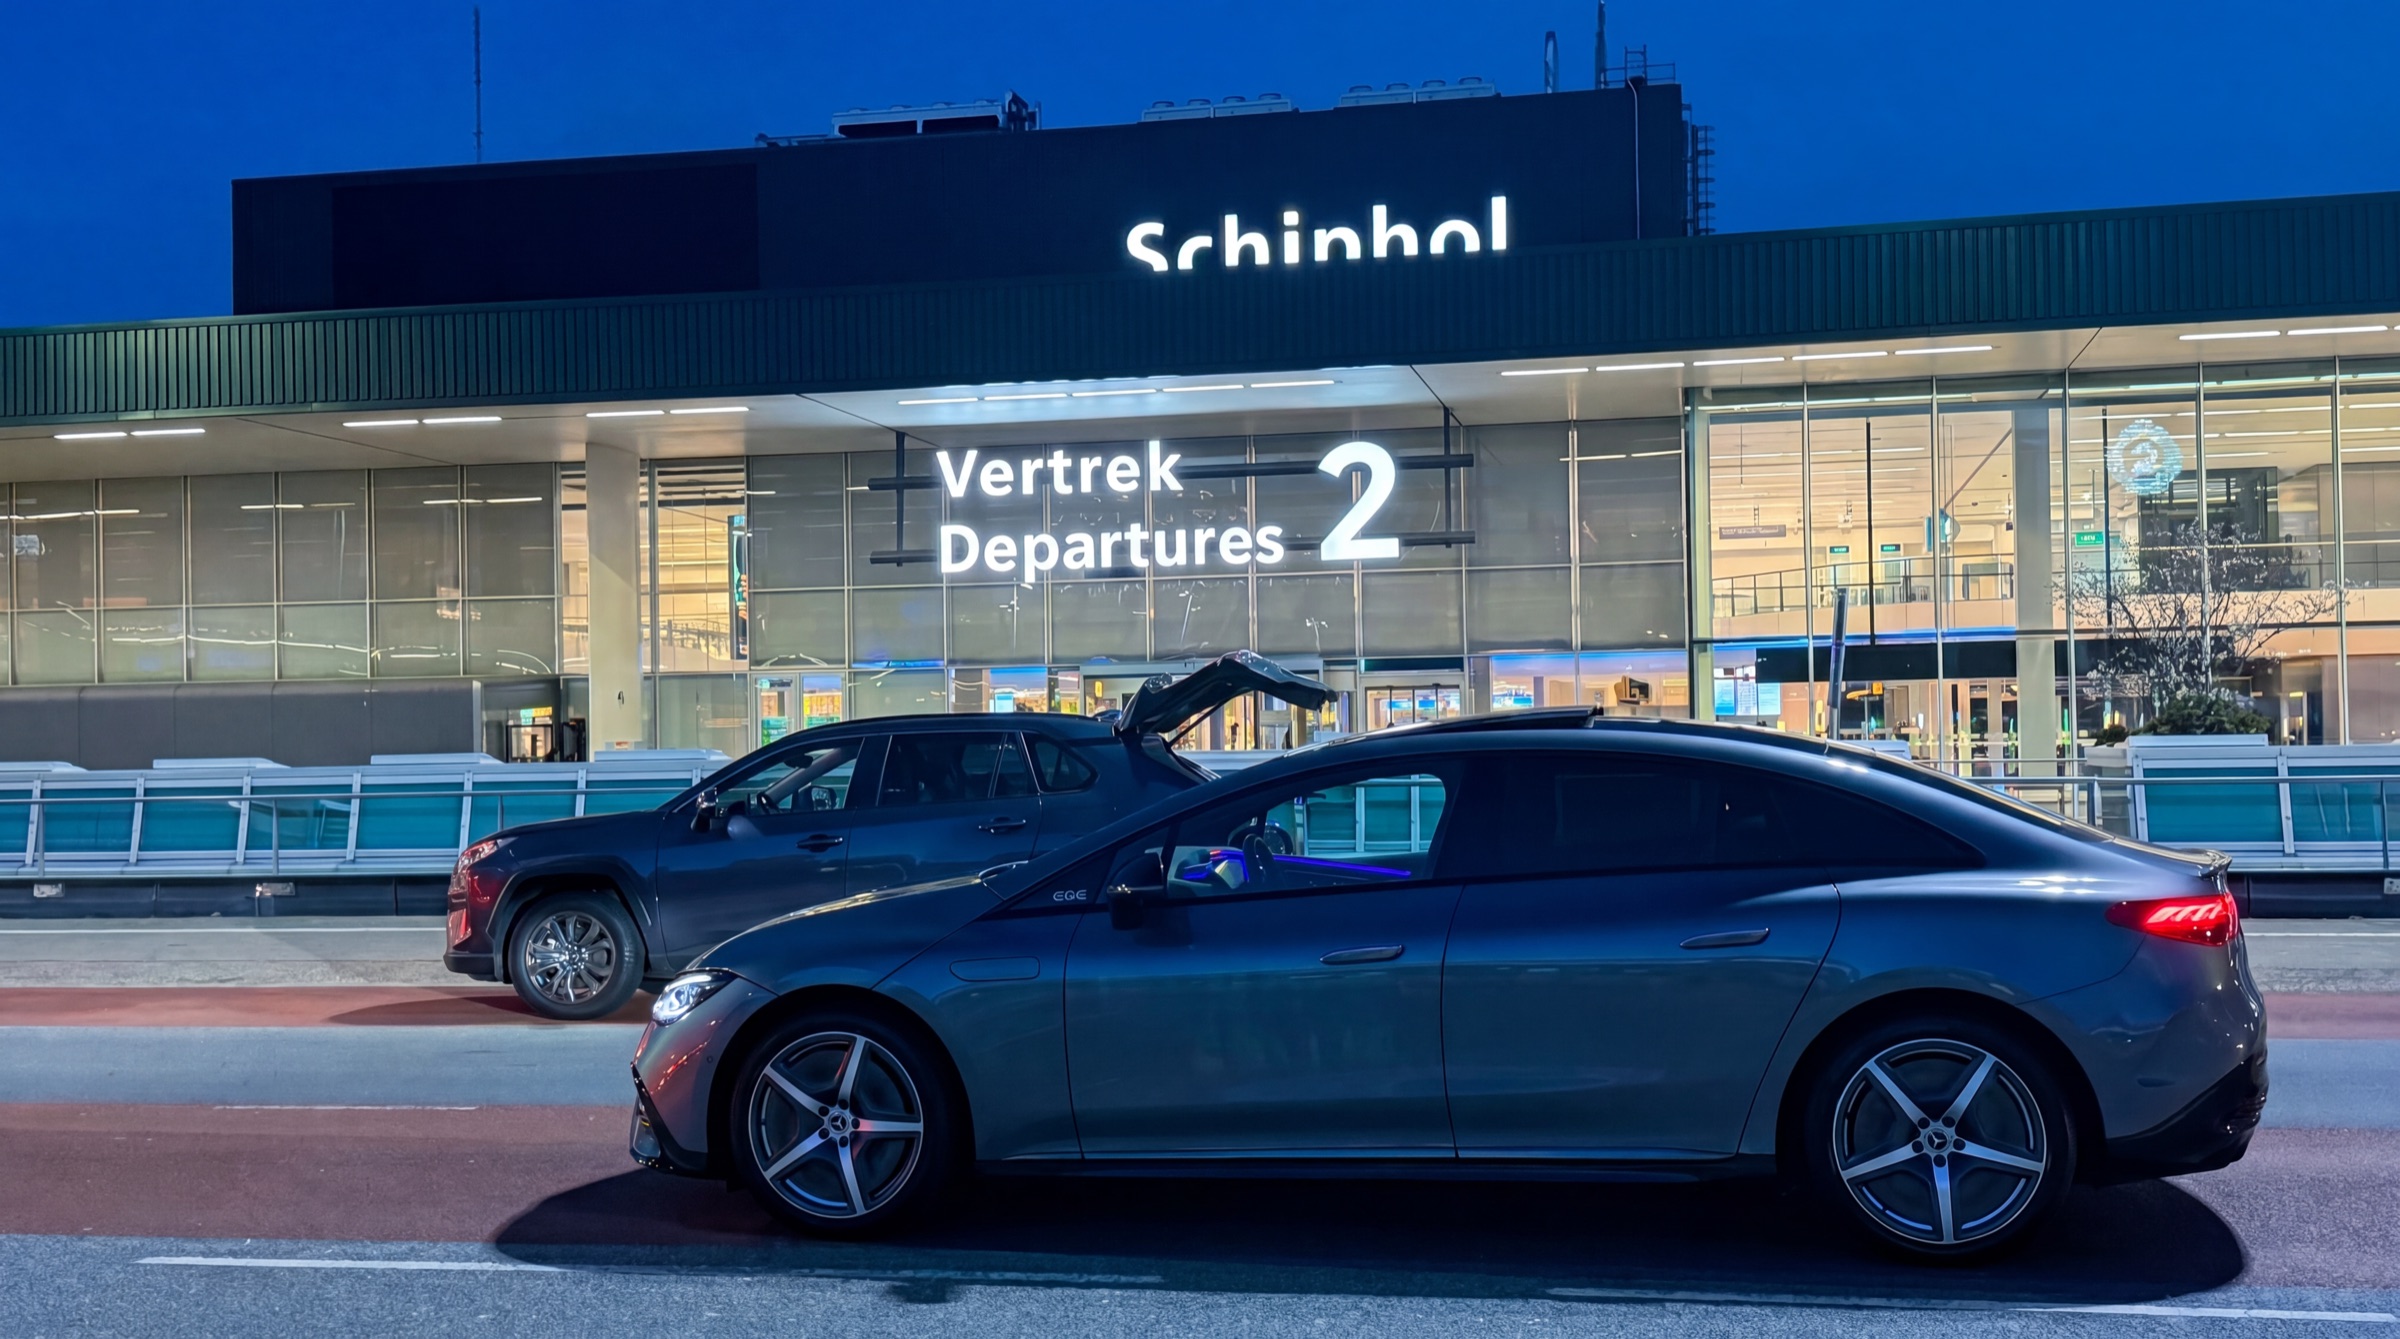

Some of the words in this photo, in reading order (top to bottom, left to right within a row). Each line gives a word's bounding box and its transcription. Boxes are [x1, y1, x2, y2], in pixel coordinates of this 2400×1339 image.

[936, 440, 1184, 498] Vertrek
[1317, 440, 1400, 561] 2
[940, 523, 1285, 583] Departures
[1053, 889, 1087, 901] EQE
